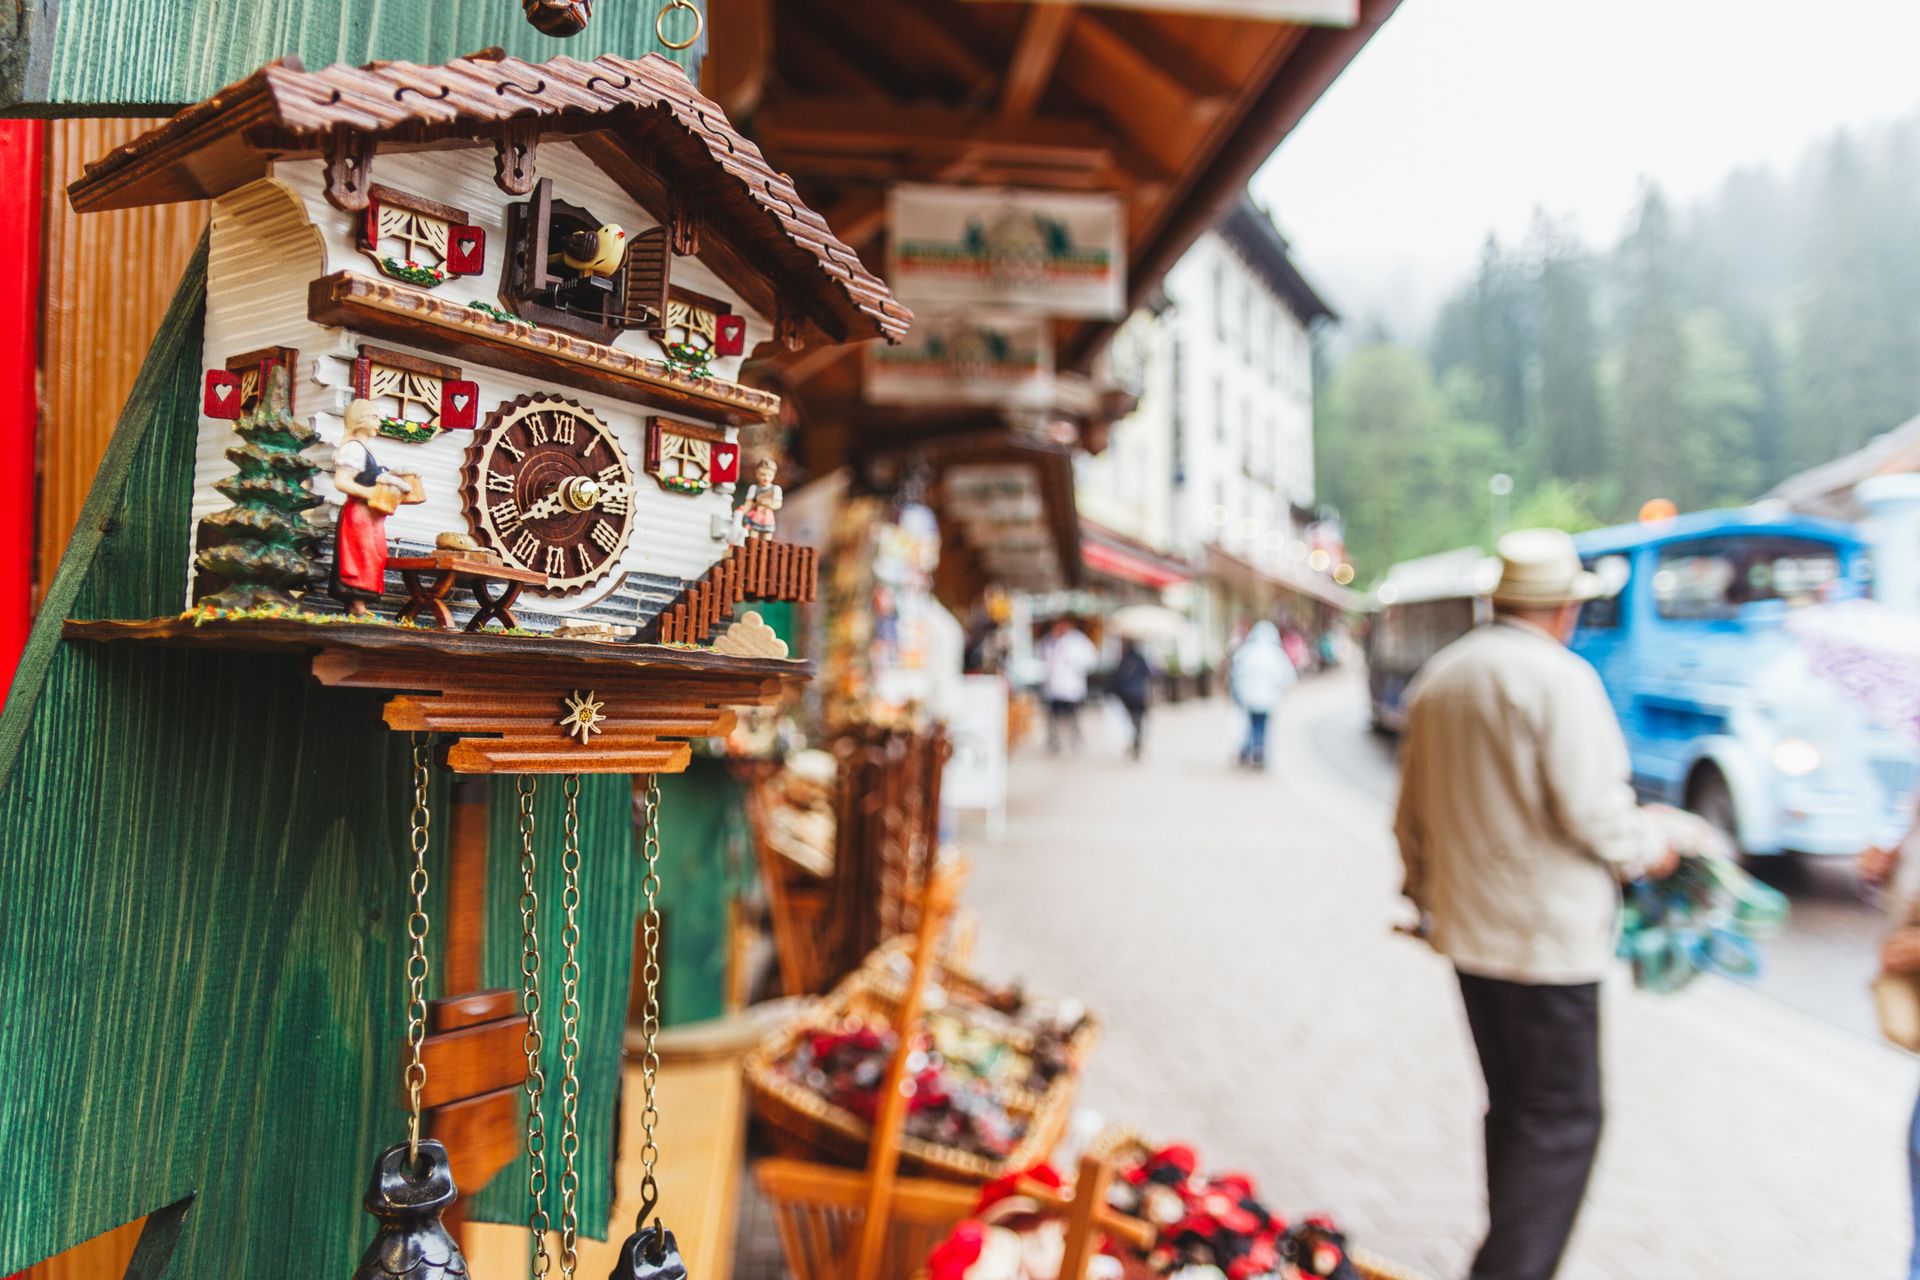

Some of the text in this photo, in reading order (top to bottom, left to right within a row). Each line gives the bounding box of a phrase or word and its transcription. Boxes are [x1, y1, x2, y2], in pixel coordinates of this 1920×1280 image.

[525, 412, 548, 446] XI
[553, 411, 575, 445] XII
[499, 433, 525, 462] X
[584, 434, 601, 457] I
[487, 470, 515, 493] IX
[598, 464, 622, 481] II
[489, 498, 523, 538] VIII
[511, 529, 540, 568] VII
[591, 518, 620, 553] IIII
[545, 545, 566, 578] VI
[578, 543, 594, 575] V
